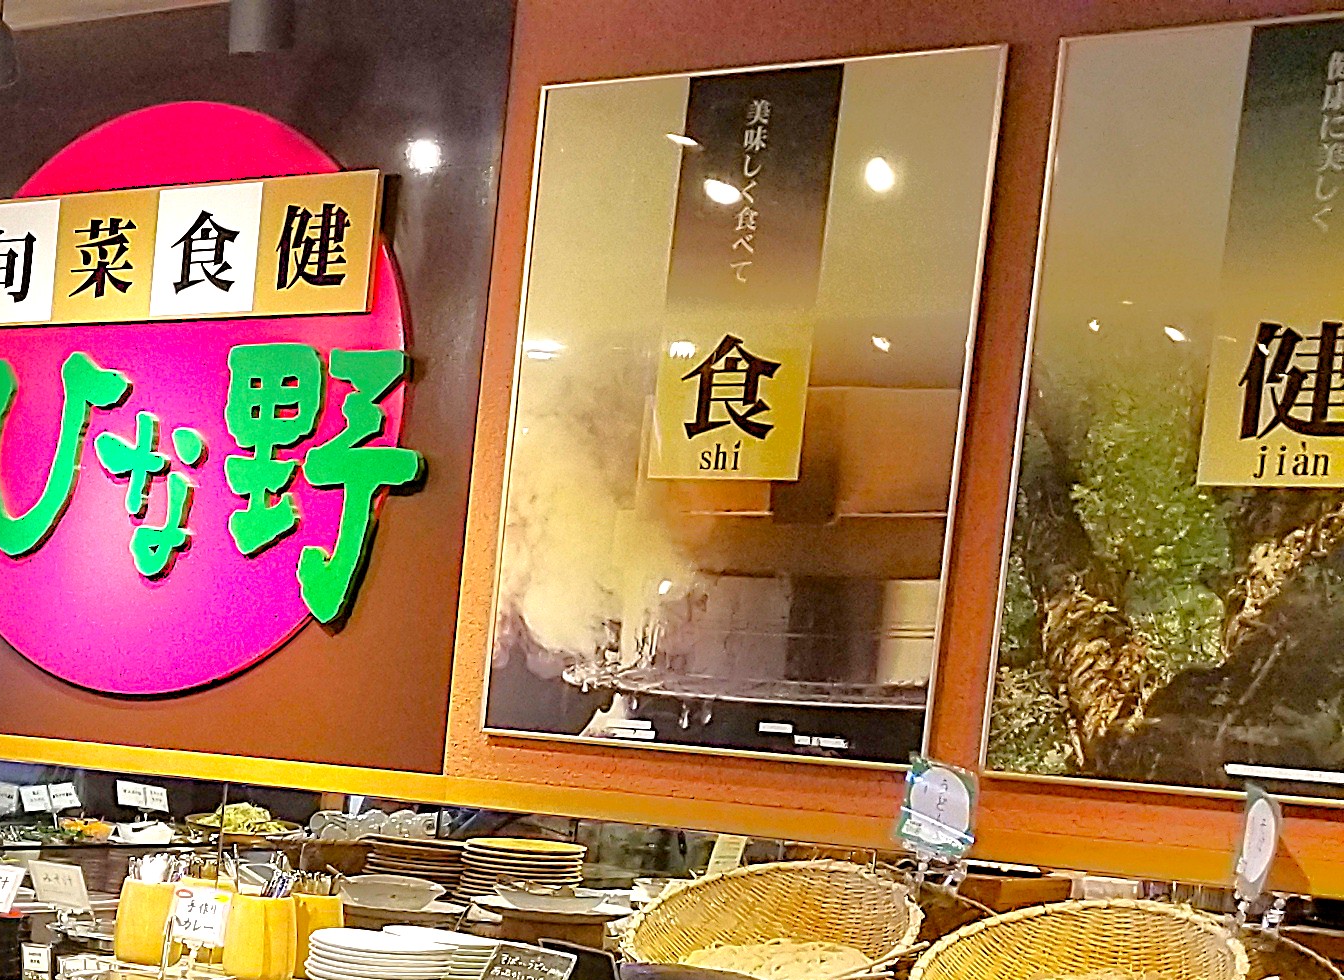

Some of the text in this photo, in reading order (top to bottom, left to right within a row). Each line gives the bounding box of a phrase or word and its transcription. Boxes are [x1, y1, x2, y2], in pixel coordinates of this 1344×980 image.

[730, 99, 772, 282] 美味しく食べて
[680, 333, 782, 441] 食
